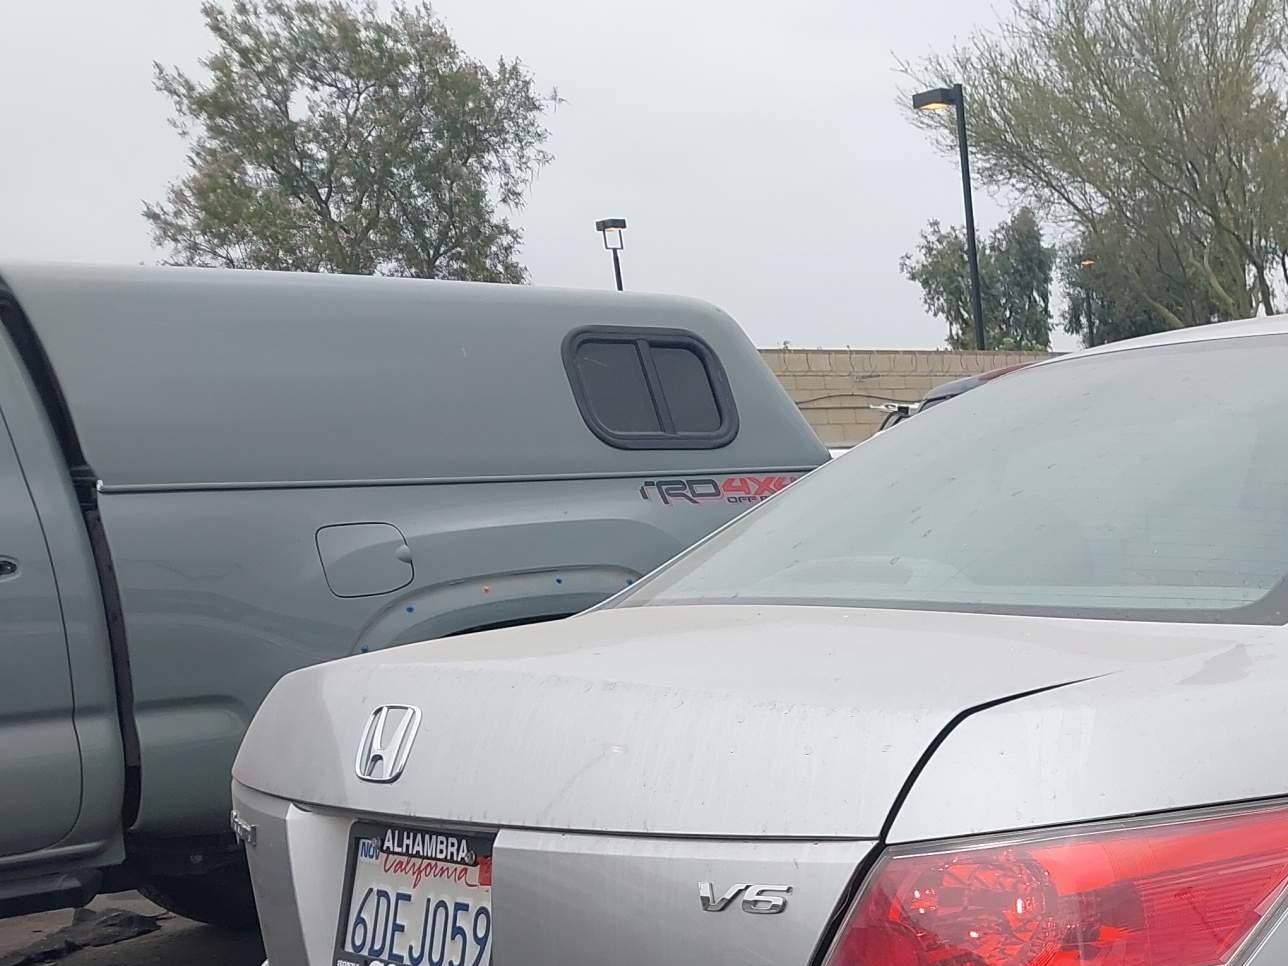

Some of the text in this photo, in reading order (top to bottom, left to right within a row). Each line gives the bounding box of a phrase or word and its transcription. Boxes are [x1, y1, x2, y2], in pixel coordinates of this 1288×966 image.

[639, 478, 722, 505] TRD
[383, 828, 469, 863] ALHAMBRA
[383, 850, 479, 889] California
[697, 881, 793, 915] V6
